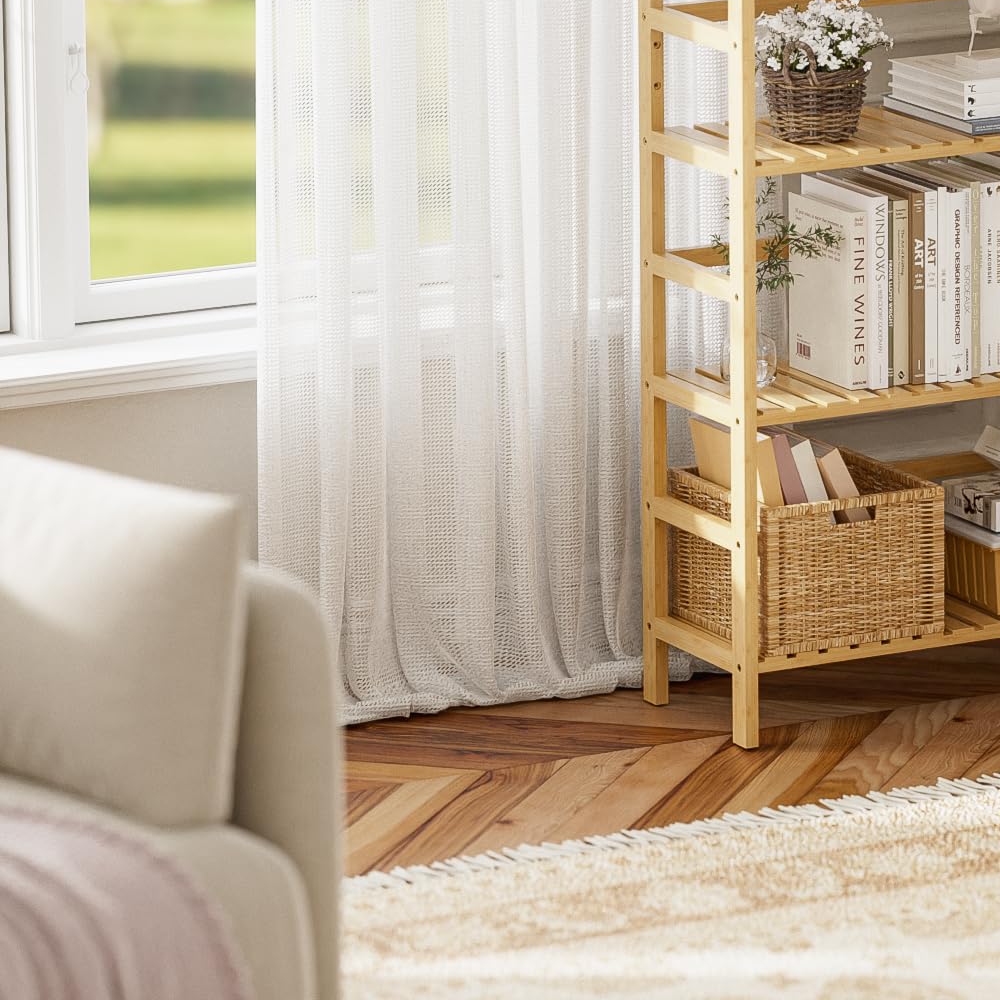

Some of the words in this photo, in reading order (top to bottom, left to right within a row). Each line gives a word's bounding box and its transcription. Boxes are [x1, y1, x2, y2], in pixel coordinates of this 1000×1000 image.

[854, 237, 865, 285] FINE
[875, 204, 885, 281] WINDOWS
[914, 238, 924, 268] ART
[927, 238, 936, 266] ART
[854, 294, 865, 366] WINES
